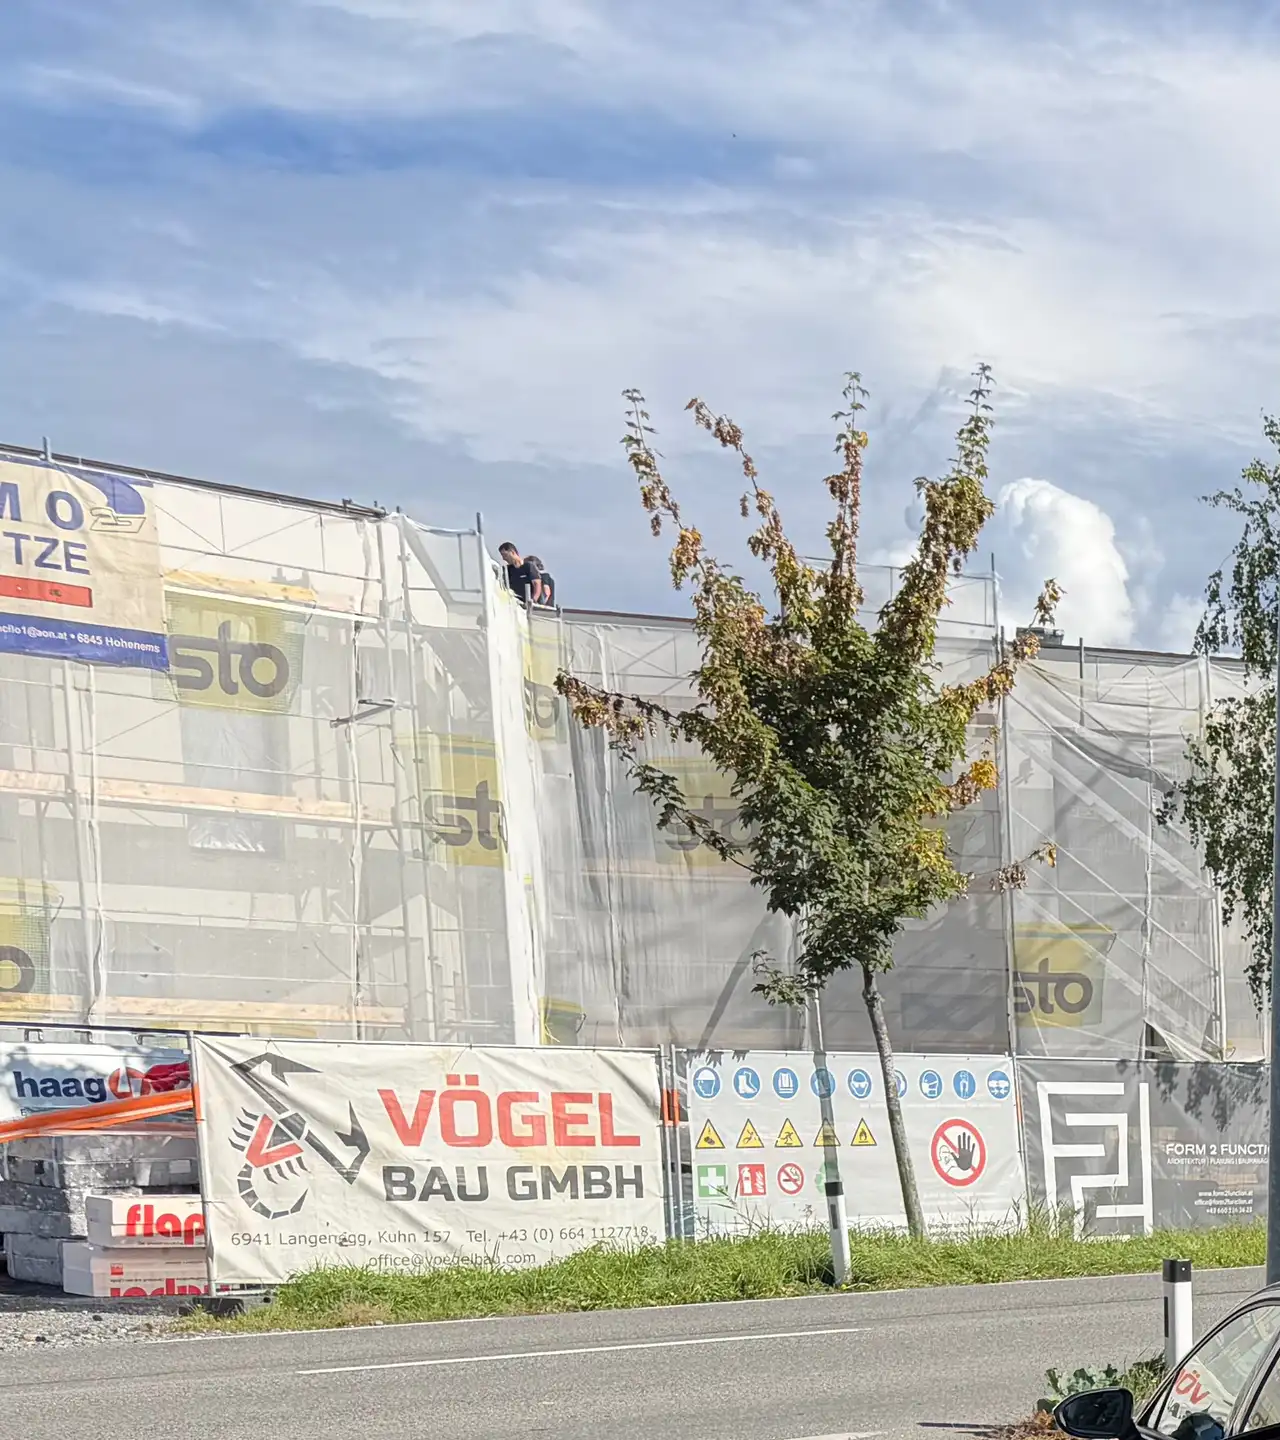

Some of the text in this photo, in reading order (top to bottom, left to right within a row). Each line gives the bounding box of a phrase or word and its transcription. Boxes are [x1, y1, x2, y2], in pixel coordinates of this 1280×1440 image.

[77, 631, 104, 647] 6845
[105, 636, 161, 654] Hohenems
[169, 619, 290, 698] sto
[13, 1070, 108, 1103] haag
[377, 1074, 642, 1148] VÖGEL
[1166, 1143, 1270, 1155] FORM 2 FUNCTI
[382, 1165, 644, 1202] BAU GMBH
[231, 1232, 272, 1246] 6941
[378, 1230, 417, 1243] Kuhn
[423, 1230, 451, 1242] 157
[466, 1229, 492, 1243] Tel.
[498, 1229, 528, 1242] +43
[533, 1227, 555, 1244] (0)
[559, 1227, 585, 1240] 664
